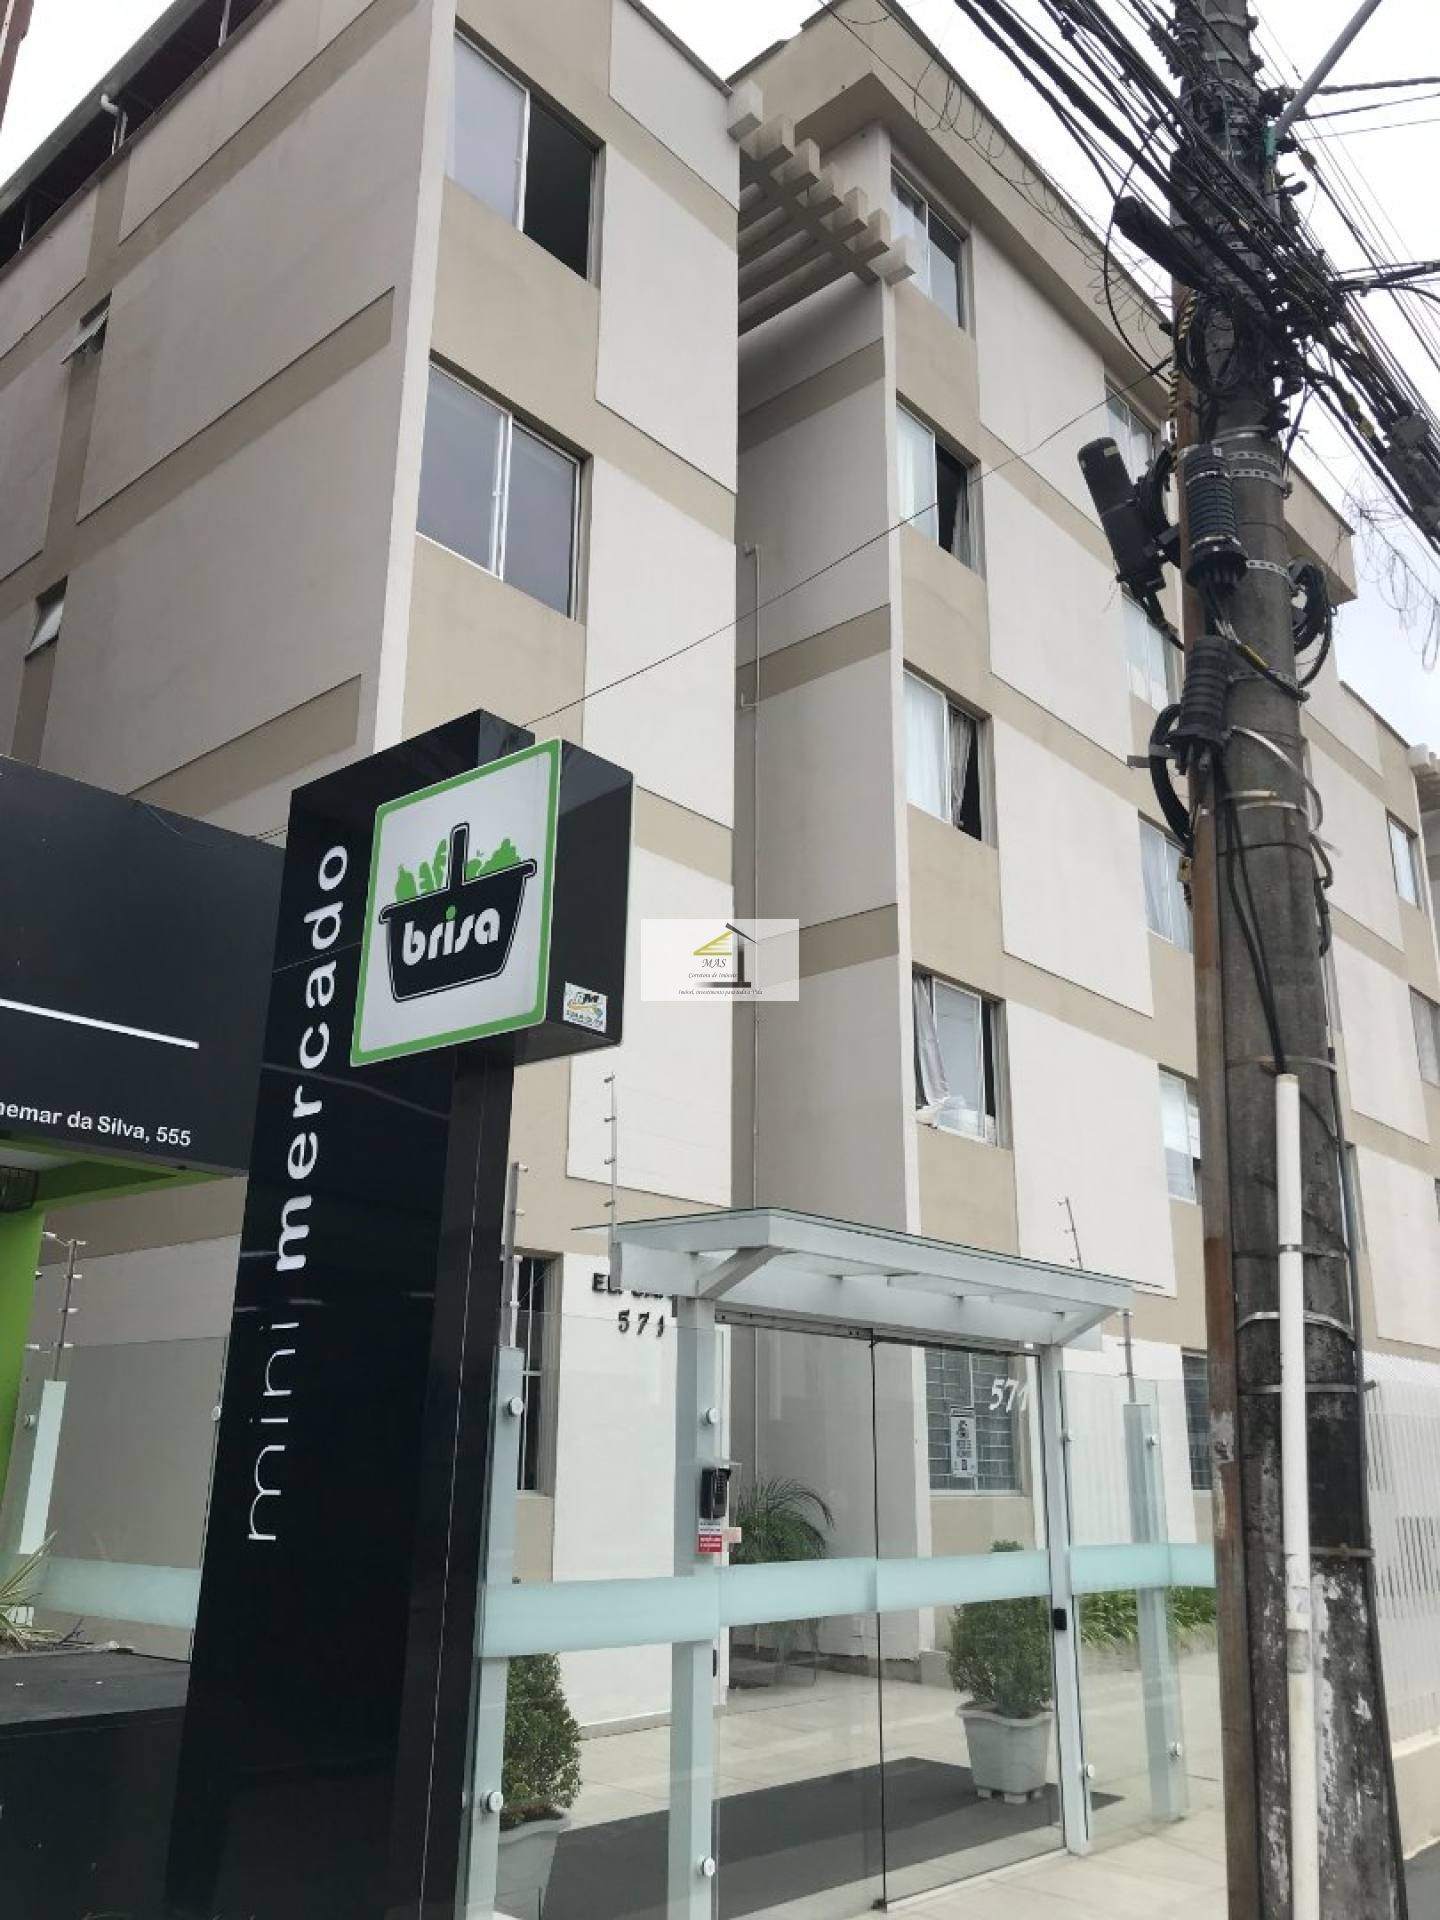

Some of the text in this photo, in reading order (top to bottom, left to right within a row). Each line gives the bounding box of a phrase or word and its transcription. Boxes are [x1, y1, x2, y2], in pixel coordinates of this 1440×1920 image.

[401, 905, 501, 967] brisa
[67, 1110, 93, 1130] da
[97, 1115, 150, 1143] Silva,
[156, 1126, 192, 1147] 555
[248, 844, 349, 1542] mini mercado
[617, 1308, 665, 1338] 571
[988, 1377, 1027, 1413] 571
